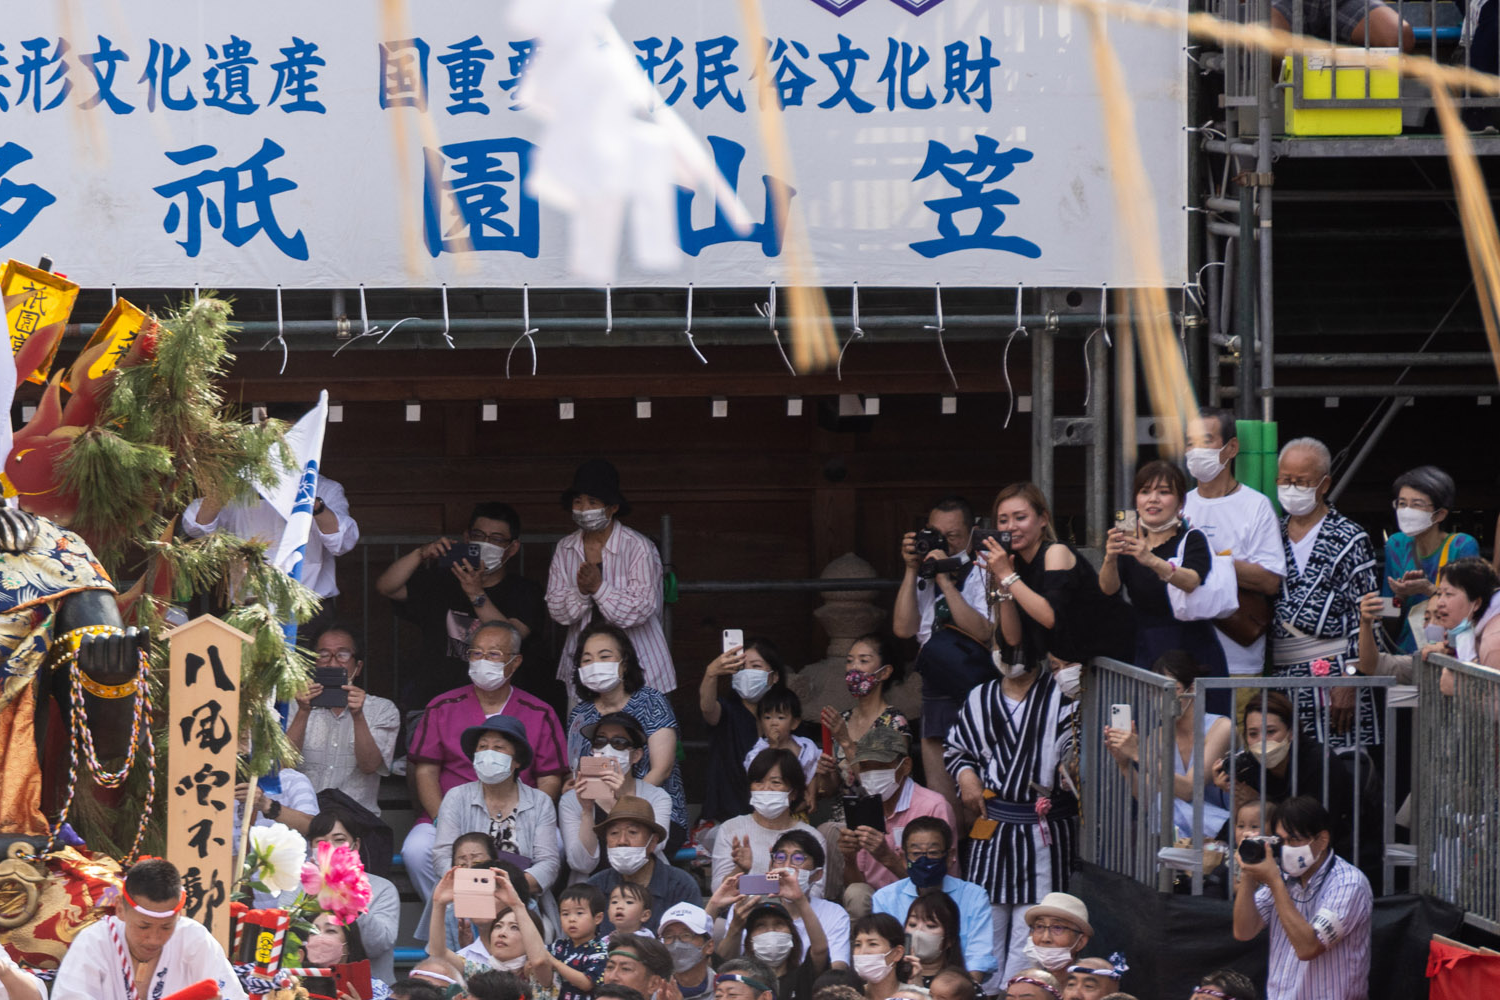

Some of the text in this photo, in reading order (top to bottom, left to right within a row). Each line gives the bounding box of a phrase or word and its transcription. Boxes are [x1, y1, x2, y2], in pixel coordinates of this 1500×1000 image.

[378, 34, 1002, 116] 国重要形民俗文化財
